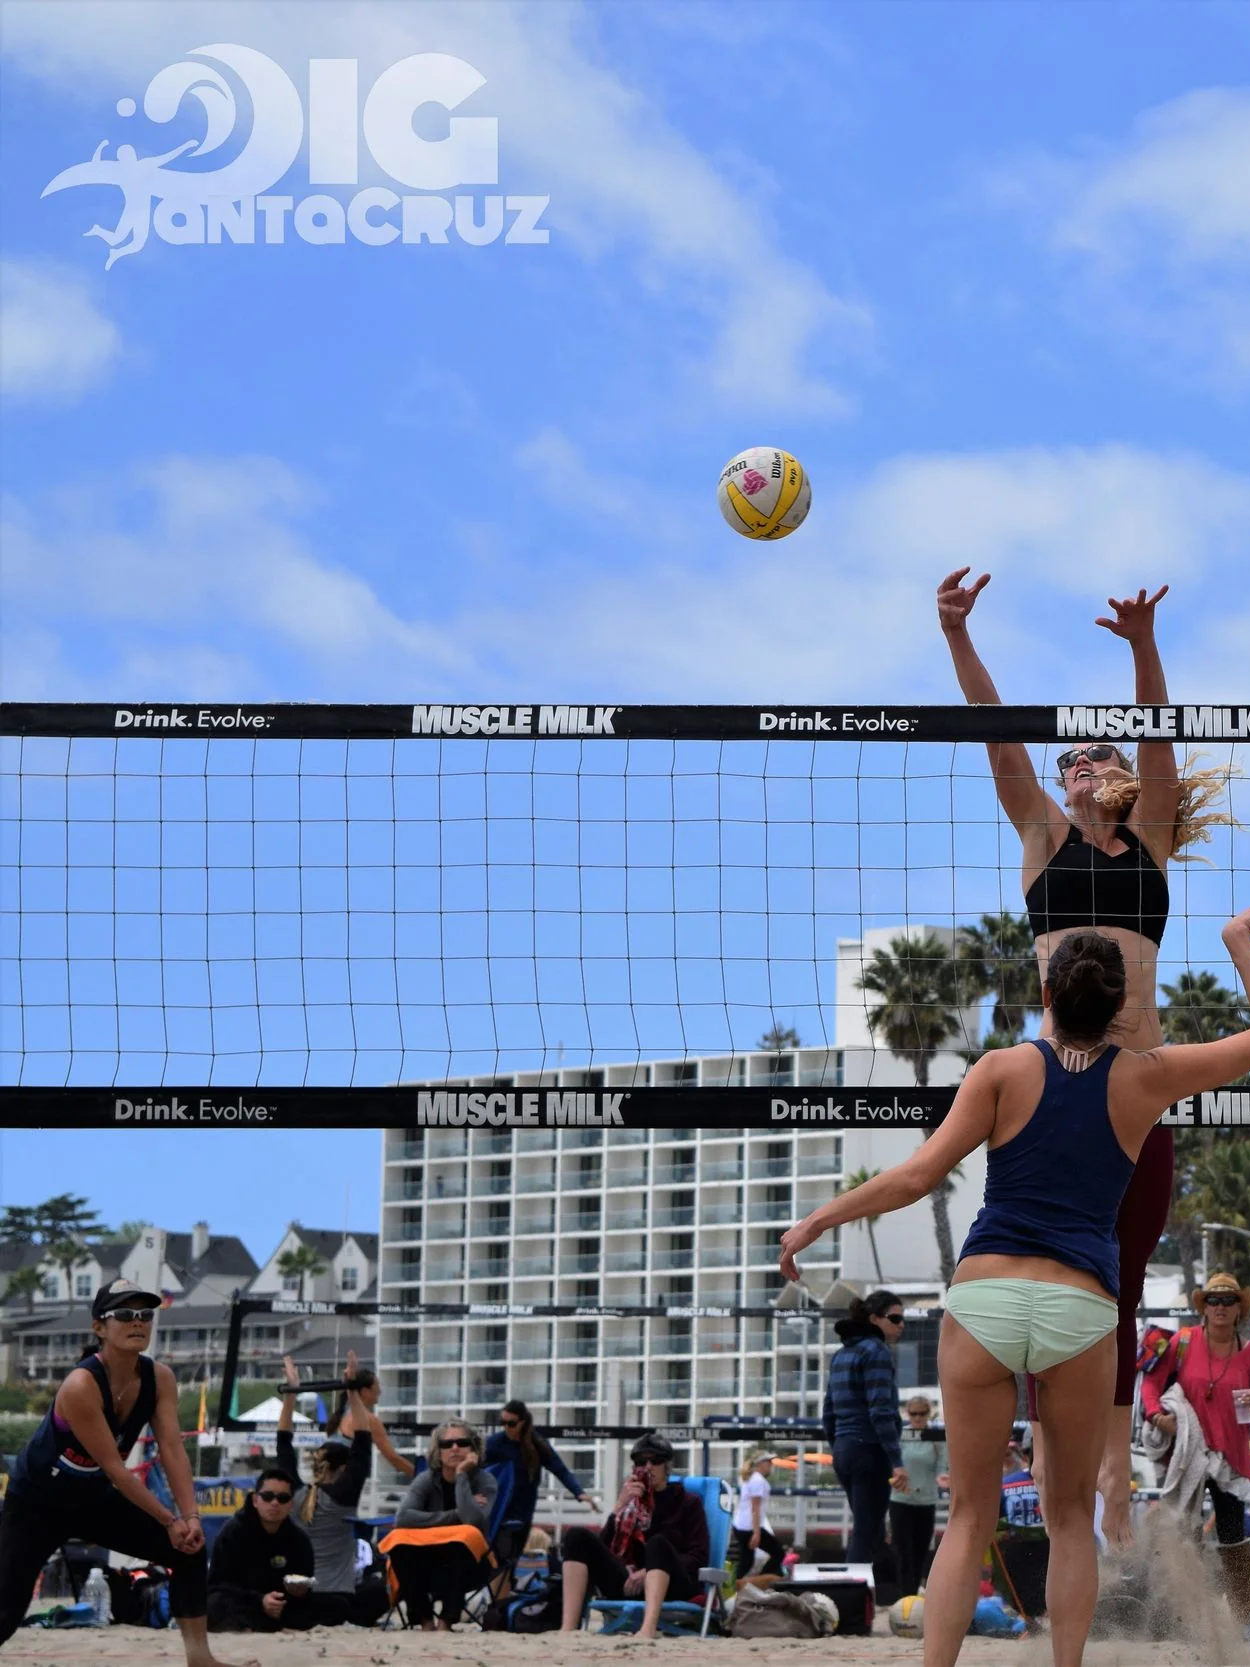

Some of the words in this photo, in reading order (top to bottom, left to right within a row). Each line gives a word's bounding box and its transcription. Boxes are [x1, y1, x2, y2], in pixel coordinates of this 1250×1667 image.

[411, 705, 533, 735] MUSCLE
[538, 705, 617, 734] MILK
[1056, 706, 1177, 737] MUSCLE
[417, 1091, 539, 1126] MUSCLE
[546, 1091, 625, 1125] MILK
[271, 1300, 310, 1313] MUSCLE
